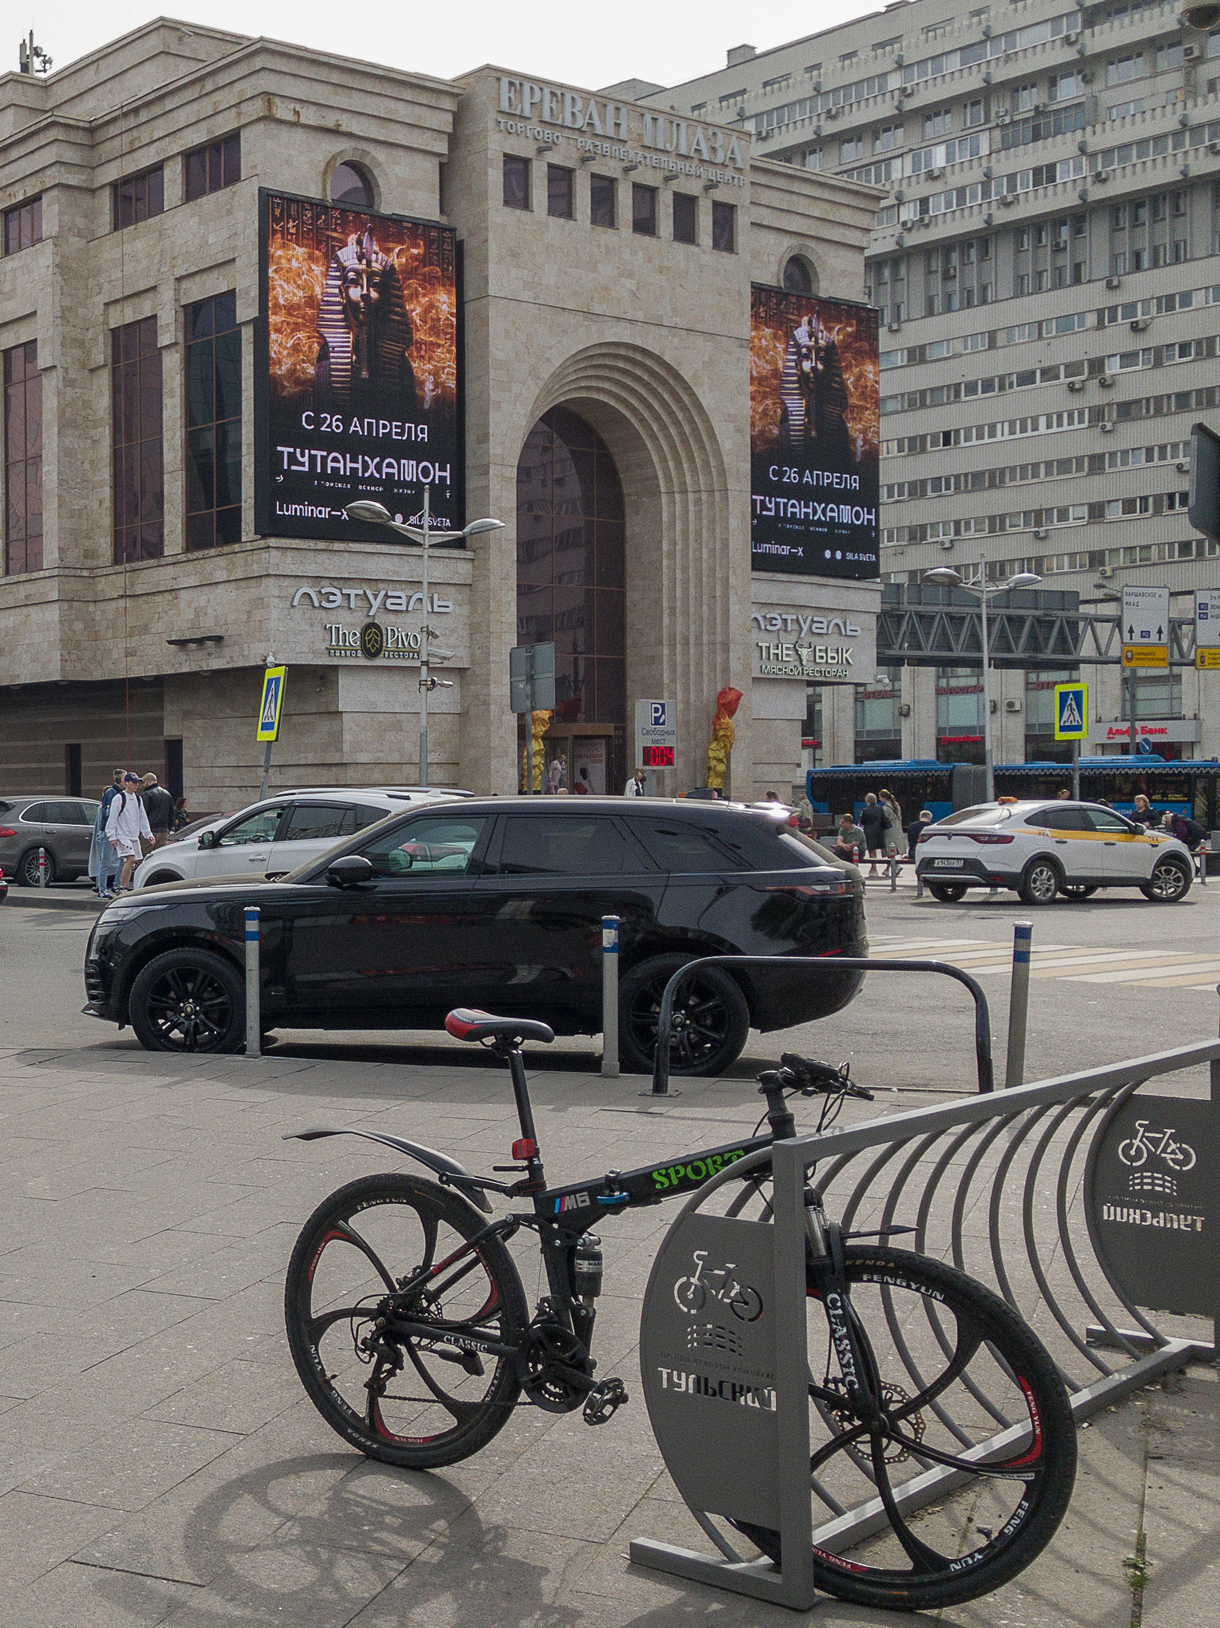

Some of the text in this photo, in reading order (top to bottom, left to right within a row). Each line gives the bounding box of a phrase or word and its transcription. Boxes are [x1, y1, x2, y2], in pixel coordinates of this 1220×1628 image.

[498, 76, 746, 170] ЕРЕВАН ПЛАЗА
[708, 167, 747, 188] ЦЕНТР
[302, 411, 428, 442] С 26 АПРЕЛЯ
[276, 446, 451, 485] ТУТАНХАМОН
[769, 465, 859, 490] С 26 АПРЕЛЯ
[752, 495, 876, 526] ТУТАНХАМОН
[325, 624, 421, 649] The Pivo
[384, 651, 422, 659] РЕСТОРА
[758, 642, 854, 665] THE БЫК
[761, 665, 849, 677] МЯСНОЙ РЕСТОРАН
[1140, 725, 1168, 735] Банк
[650, 746, 675, 766] 004
[651, 1149, 745, 1190] SPORT
[845, 1259, 895, 1268] KENDA
[862, 1273, 945, 1301] FENGYUN
[443, 1335, 488, 1353] CLASSIC
[826, 1293, 859, 1389] CLASSIC
[657, 1366, 777, 1412] ТУЛЬСКИЙ
[1026, 1391, 1037, 1414] FENG
[949, 1500, 1030, 1572] FENG YUN
